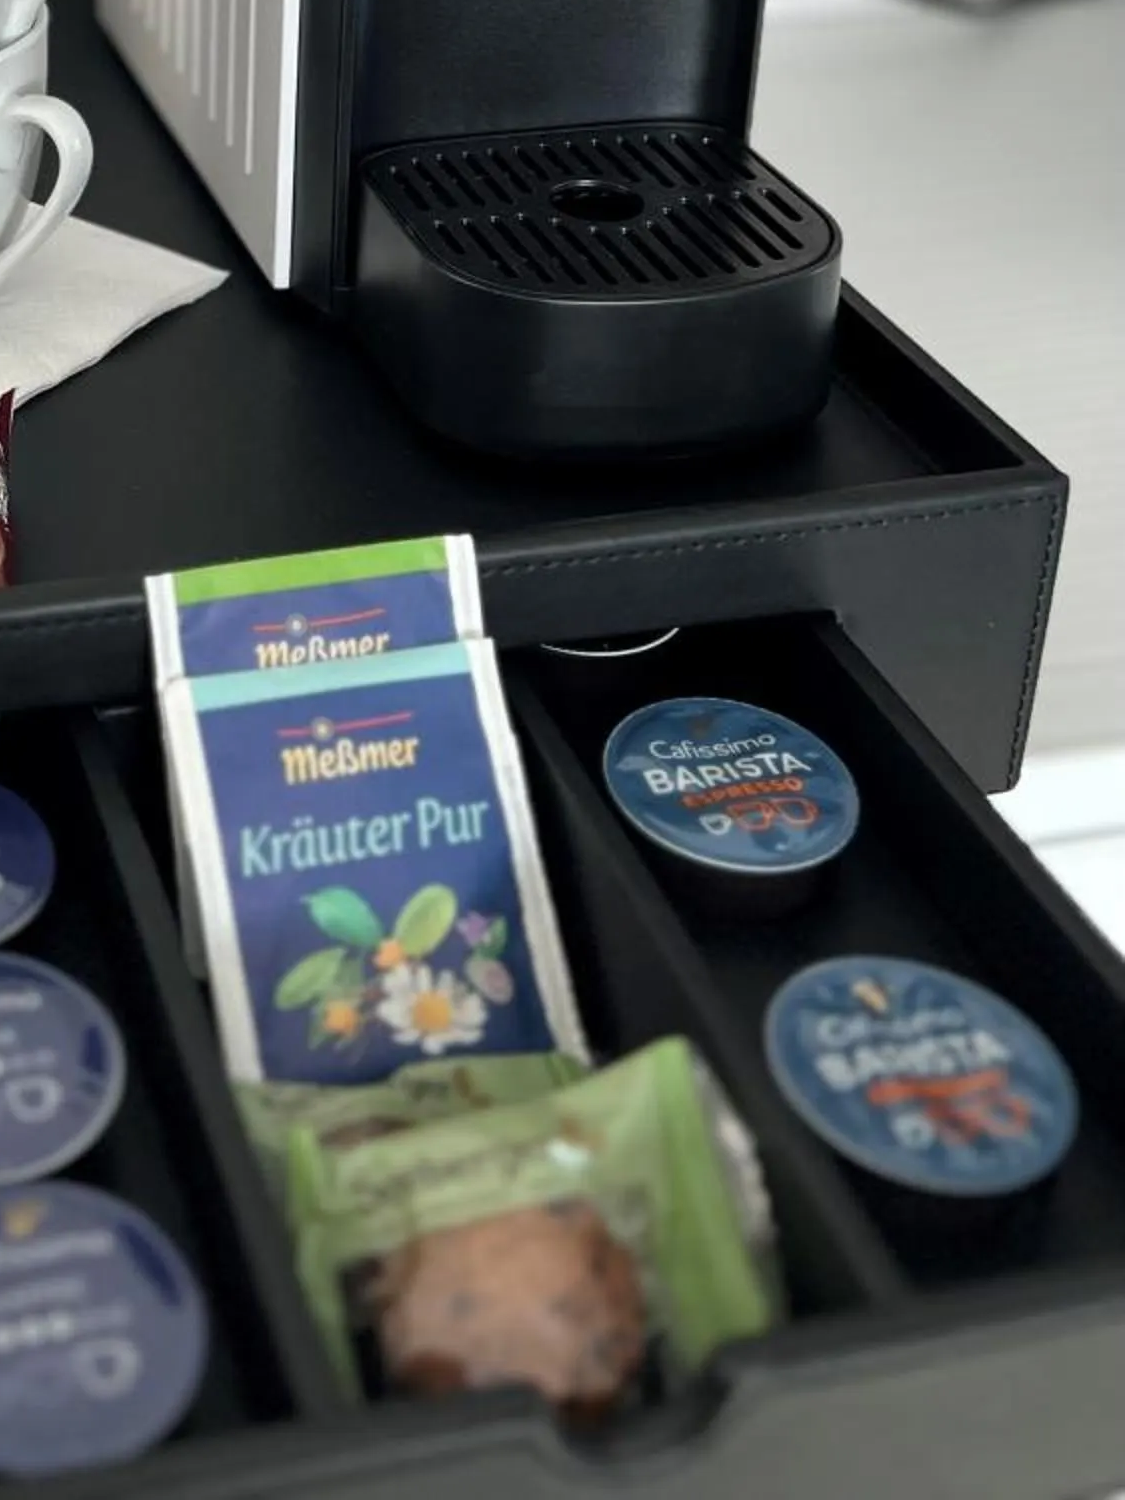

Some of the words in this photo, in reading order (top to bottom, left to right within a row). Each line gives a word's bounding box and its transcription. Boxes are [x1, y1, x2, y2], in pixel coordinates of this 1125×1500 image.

[281, 736, 421, 786] Meßmer
[650, 733, 777, 760] Cafissimo
[643, 752, 813, 796] BARISTA
[240, 810, 412, 878] Kräuter
[415, 796, 491, 850] Pur
